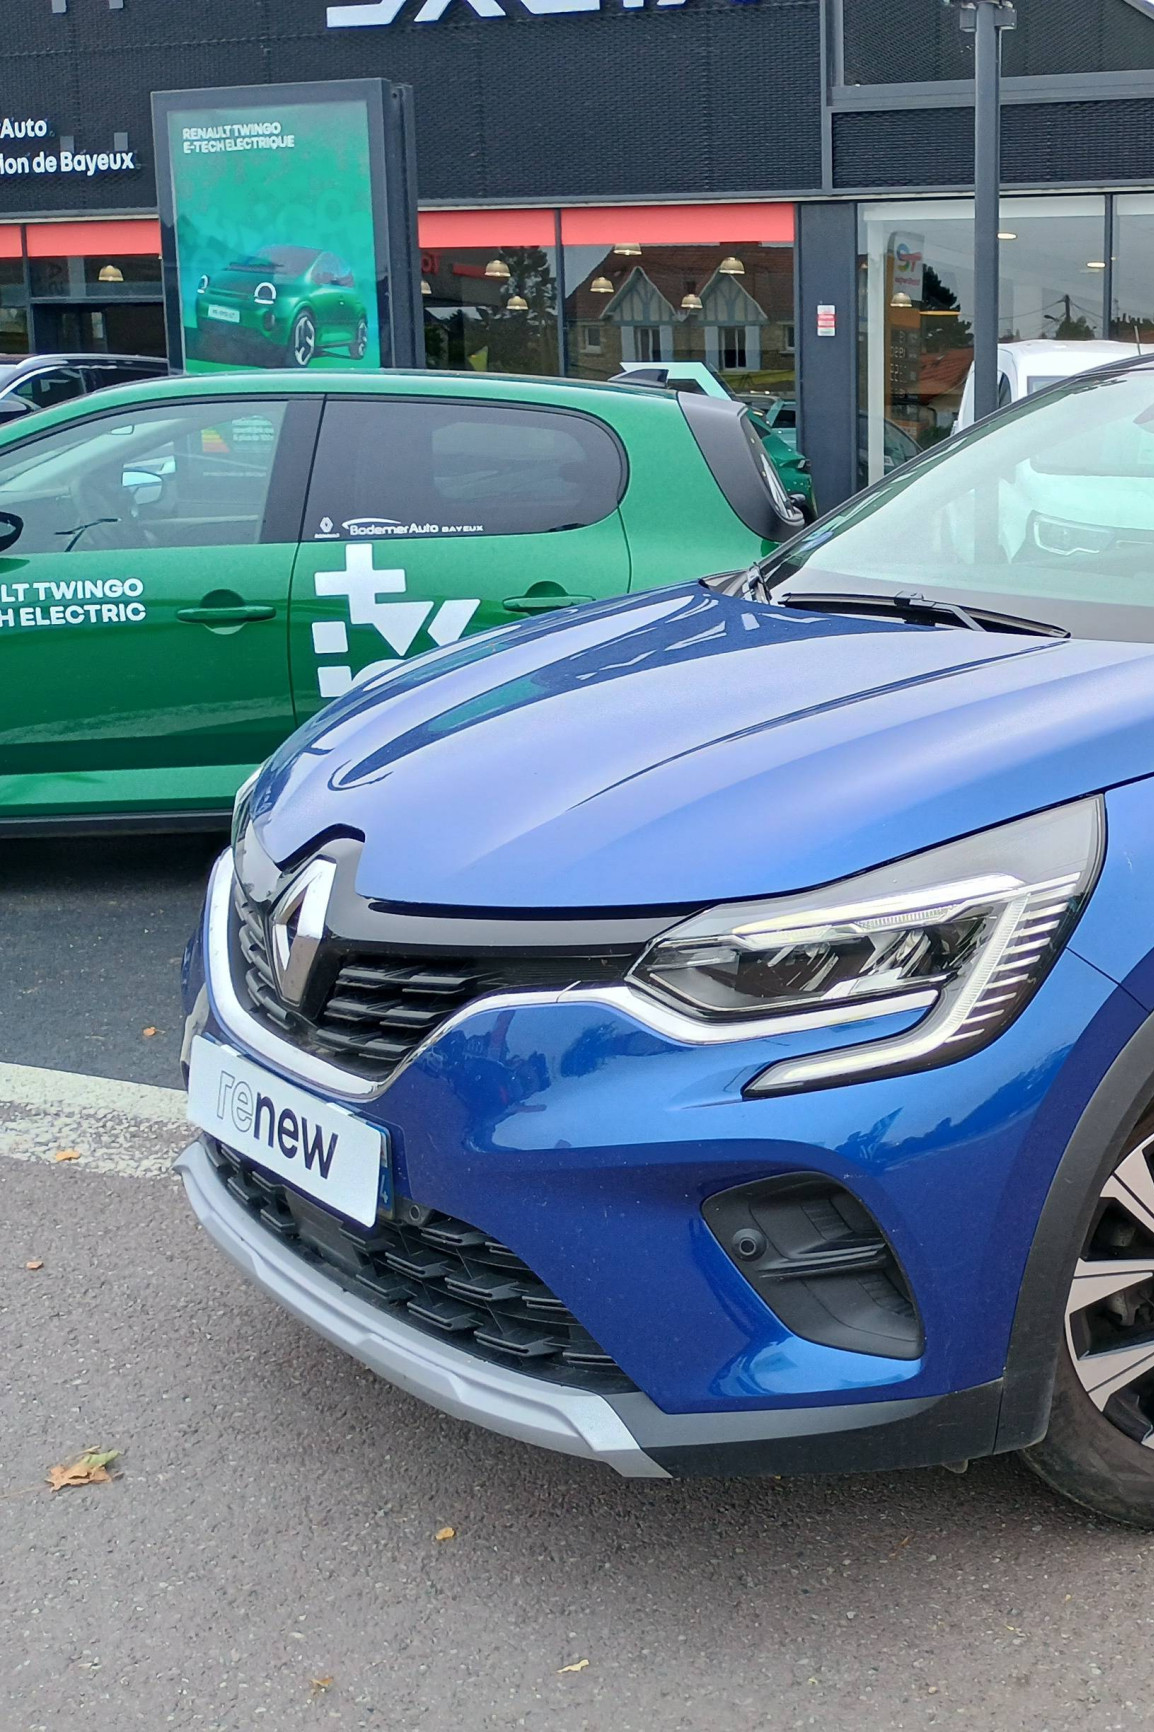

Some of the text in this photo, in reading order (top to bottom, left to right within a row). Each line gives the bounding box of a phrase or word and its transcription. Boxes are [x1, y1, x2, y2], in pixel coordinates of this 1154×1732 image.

[0, 118, 48, 139] Auto
[182, 121, 281, 140] RENAULT TWINGO
[183, 134, 295, 153] E-TECH ELECTRIQUE
[32, 151, 57, 173] de
[60, 151, 135, 176] Bayeux
[441, 524, 484, 533] BAYEUX
[33, 578, 144, 600] TWINGO
[20, 602, 147, 627] ELECTRIC
[216, 1070, 339, 1180] renew
